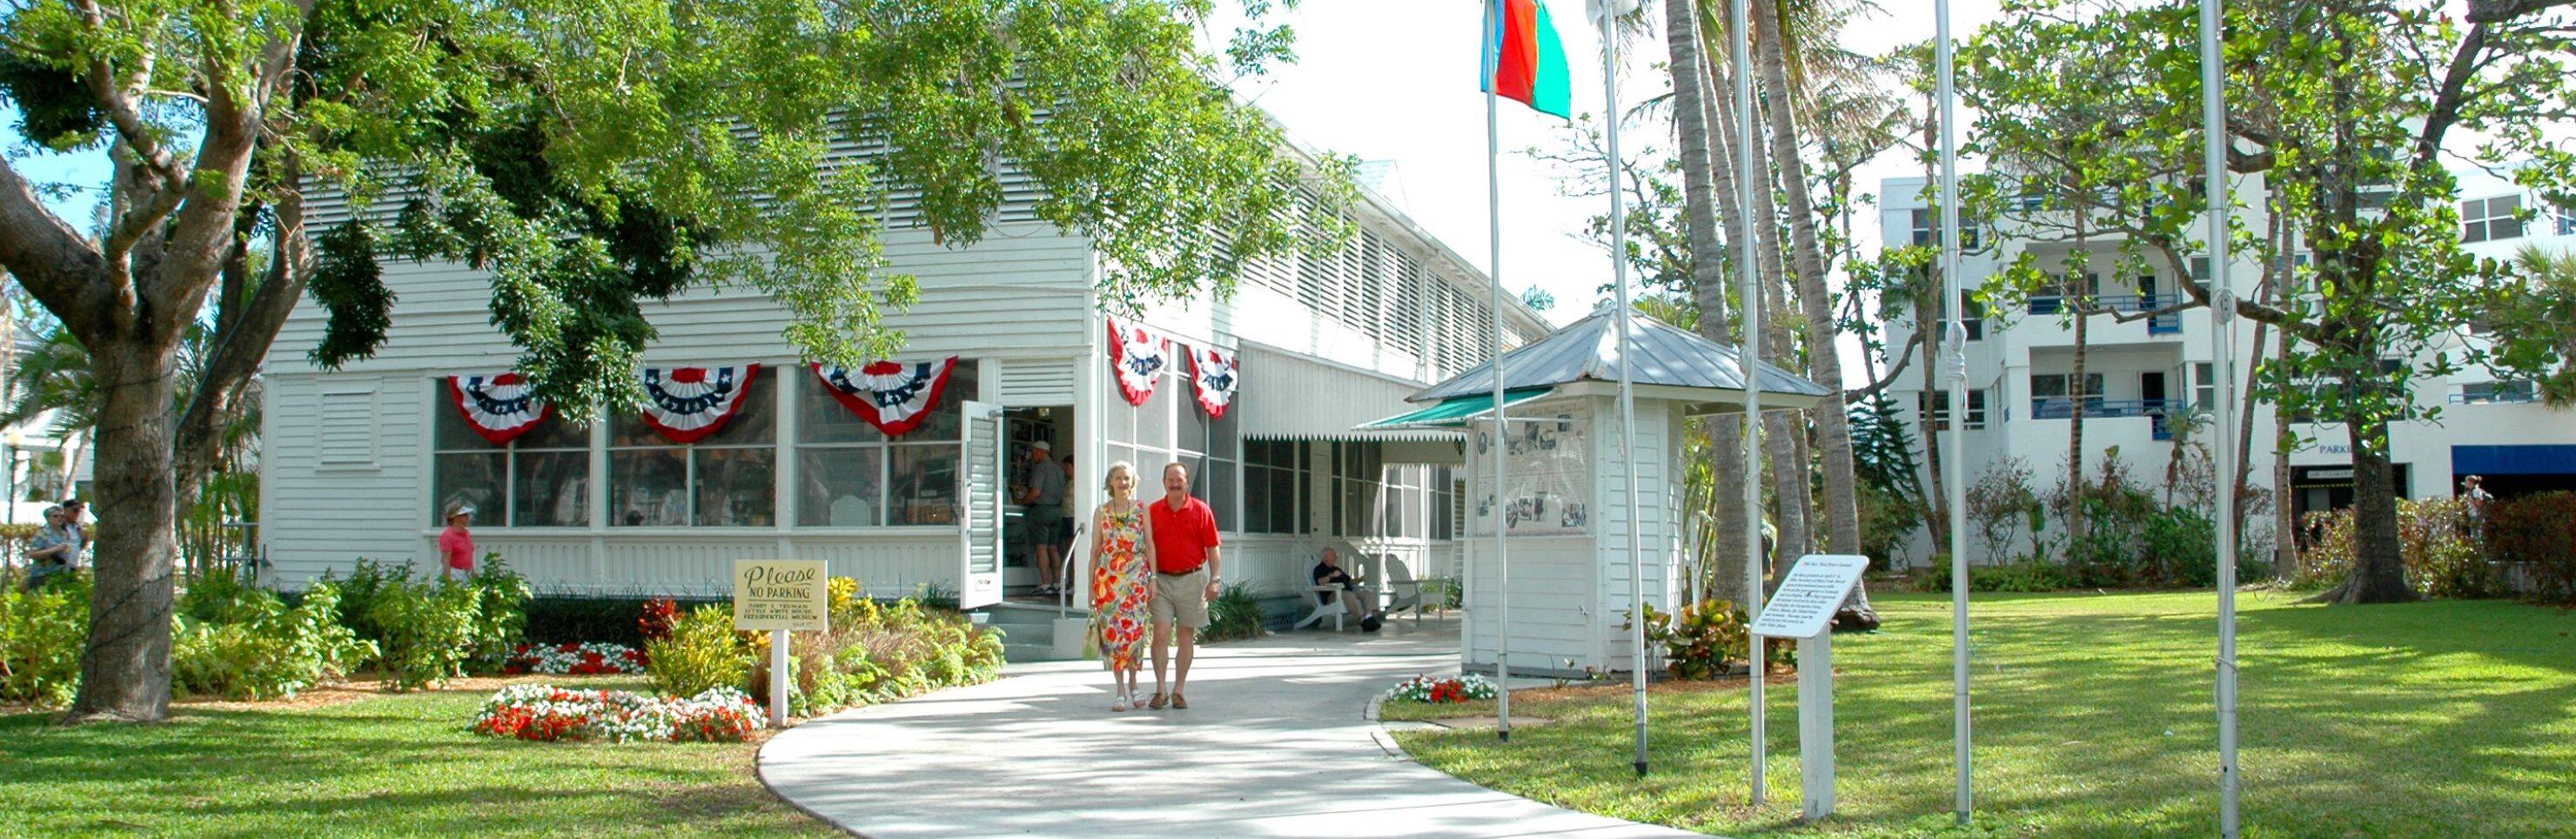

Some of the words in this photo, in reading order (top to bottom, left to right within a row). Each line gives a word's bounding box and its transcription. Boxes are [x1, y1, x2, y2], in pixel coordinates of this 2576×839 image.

[2319, 445, 2351, 453] PARKI
[744, 566, 815, 588] Please
[749, 587, 764, 598] NO
[767, 587, 810, 599] PARKING
